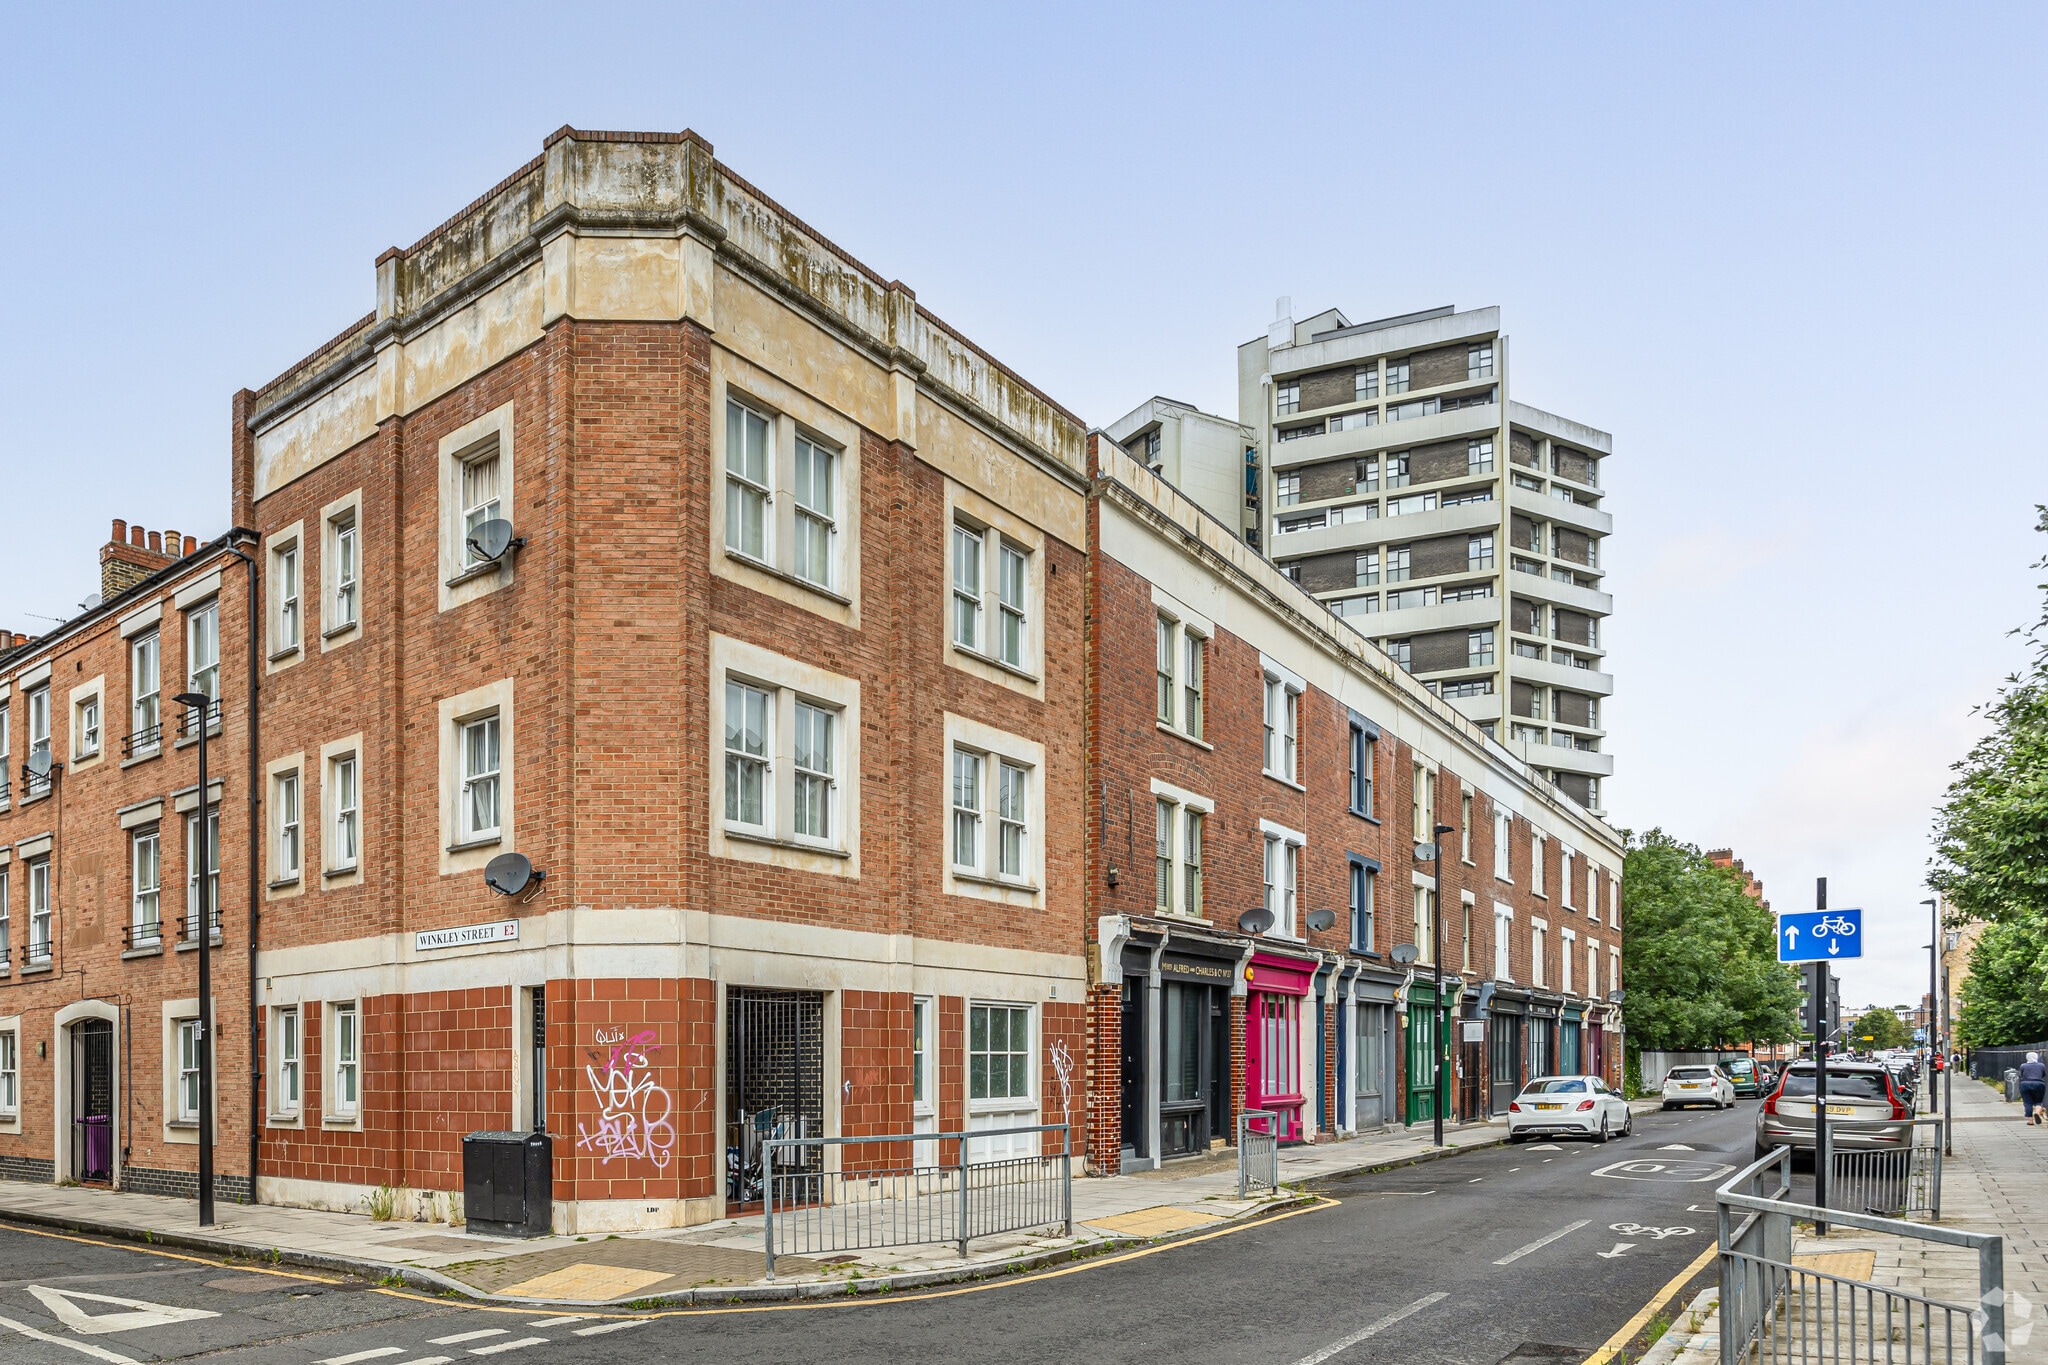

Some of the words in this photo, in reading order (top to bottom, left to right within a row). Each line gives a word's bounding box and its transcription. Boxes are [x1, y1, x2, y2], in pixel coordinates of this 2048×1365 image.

[420, 931, 460, 946] WINKLEY
[461, 926, 496, 942] STREET
[504, 924, 515, 936] E2
[1173, 963, 1189, 974] ALFRED
[1195, 966, 1214, 977] CHARLES
